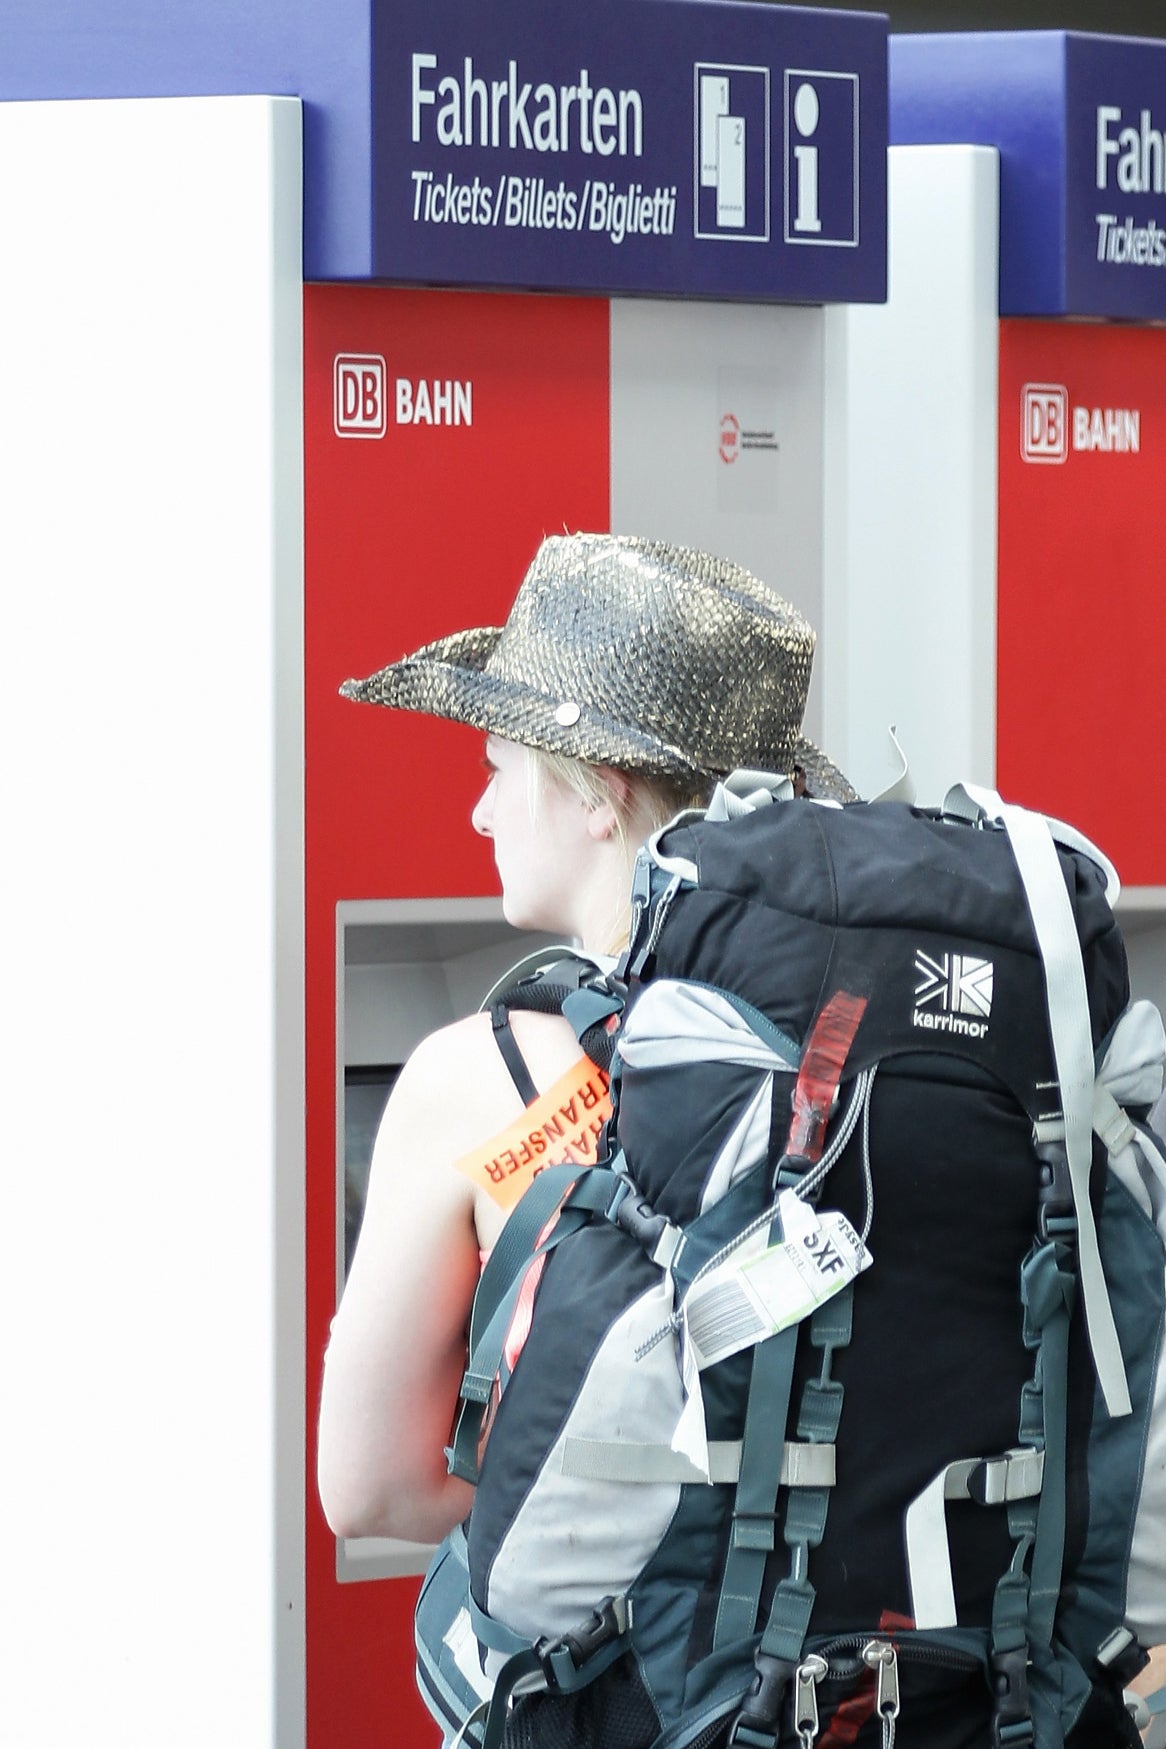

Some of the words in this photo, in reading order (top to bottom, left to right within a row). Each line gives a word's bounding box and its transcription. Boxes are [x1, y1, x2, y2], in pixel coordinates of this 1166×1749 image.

[411, 52, 643, 156] Fahrkarten
[411, 170, 677, 244] Tickets/Billets/Biglietti
[342, 369, 379, 421] DB
[396, 378, 472, 426] BAHN
[1029, 400, 1059, 446] DB
[1073, 405, 1140, 453] BAHN
[913, 1008, 989, 1039] karrimor
[484, 1071, 609, 1184] TRANSFER
